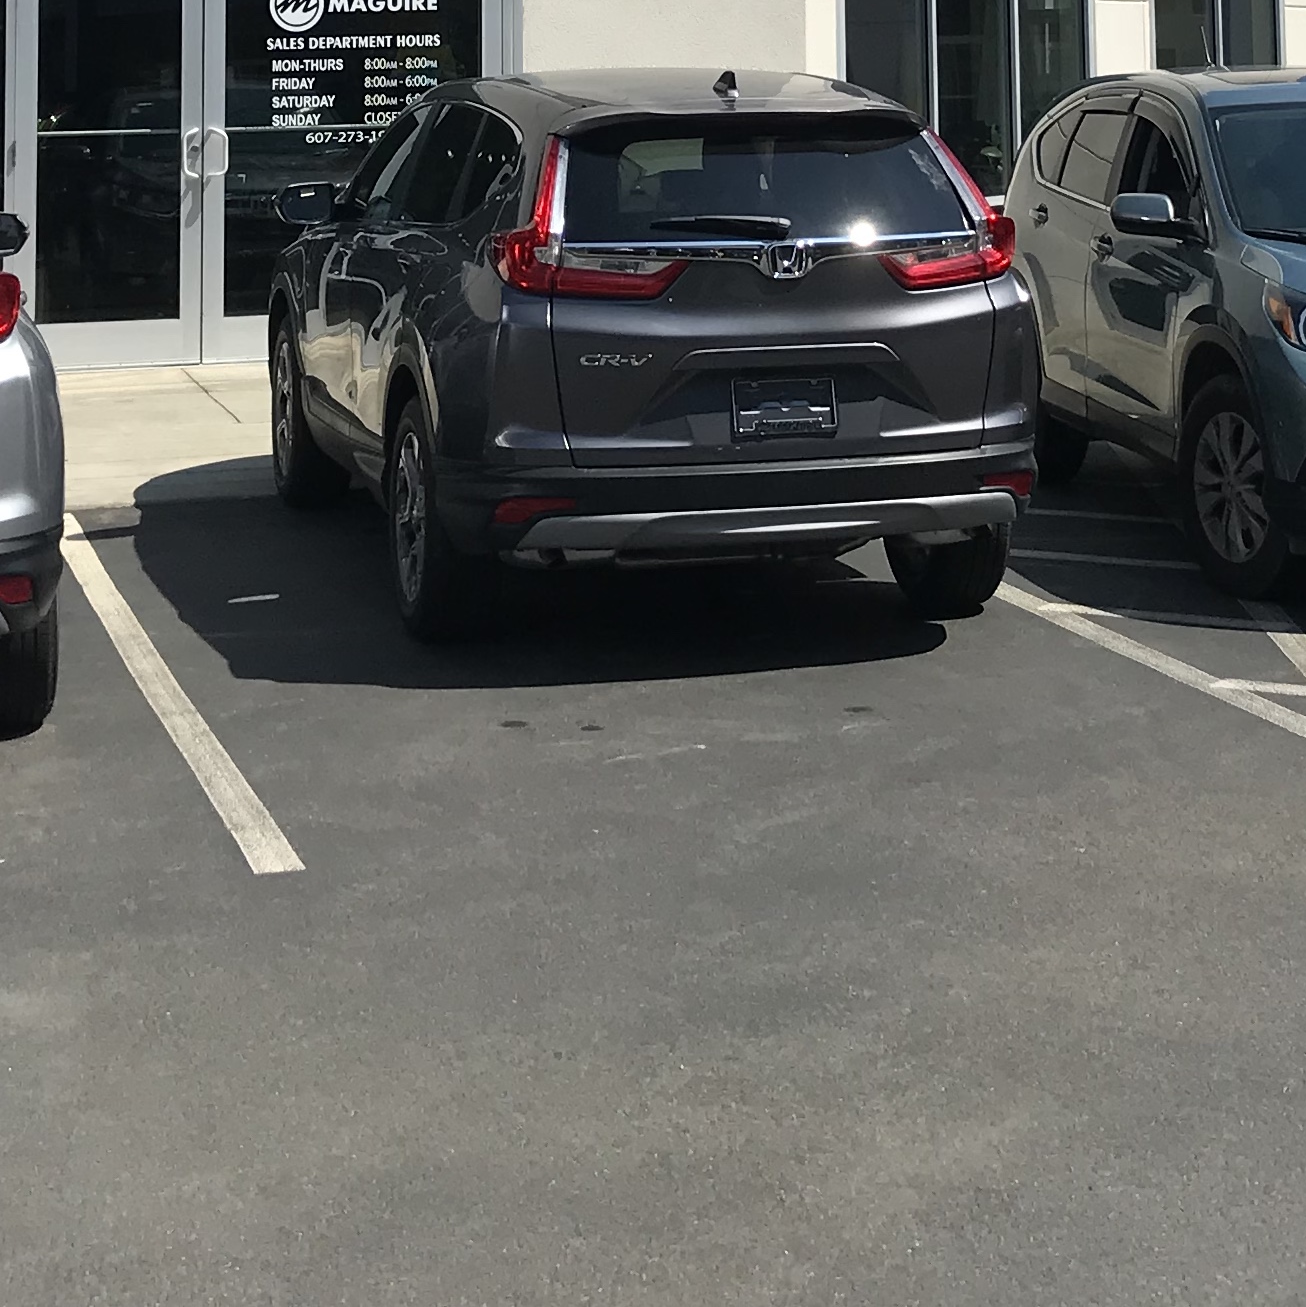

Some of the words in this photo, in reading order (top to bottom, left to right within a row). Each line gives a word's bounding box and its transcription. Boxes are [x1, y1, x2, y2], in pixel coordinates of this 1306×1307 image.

[266, 37, 305, 51] SALES
[308, 35, 391, 49] DEPARTMENT
[396, 33, 441, 48] HOURS
[271, 58, 344, 72] MON-THURS
[271, 77, 316, 90] FRIDAY
[271, 94, 336, 109] SATURDAY
[271, 113, 322, 127] SUNDAY
[364, 112, 402, 125] CLOSE
[579, 353, 653, 367] CR-V
